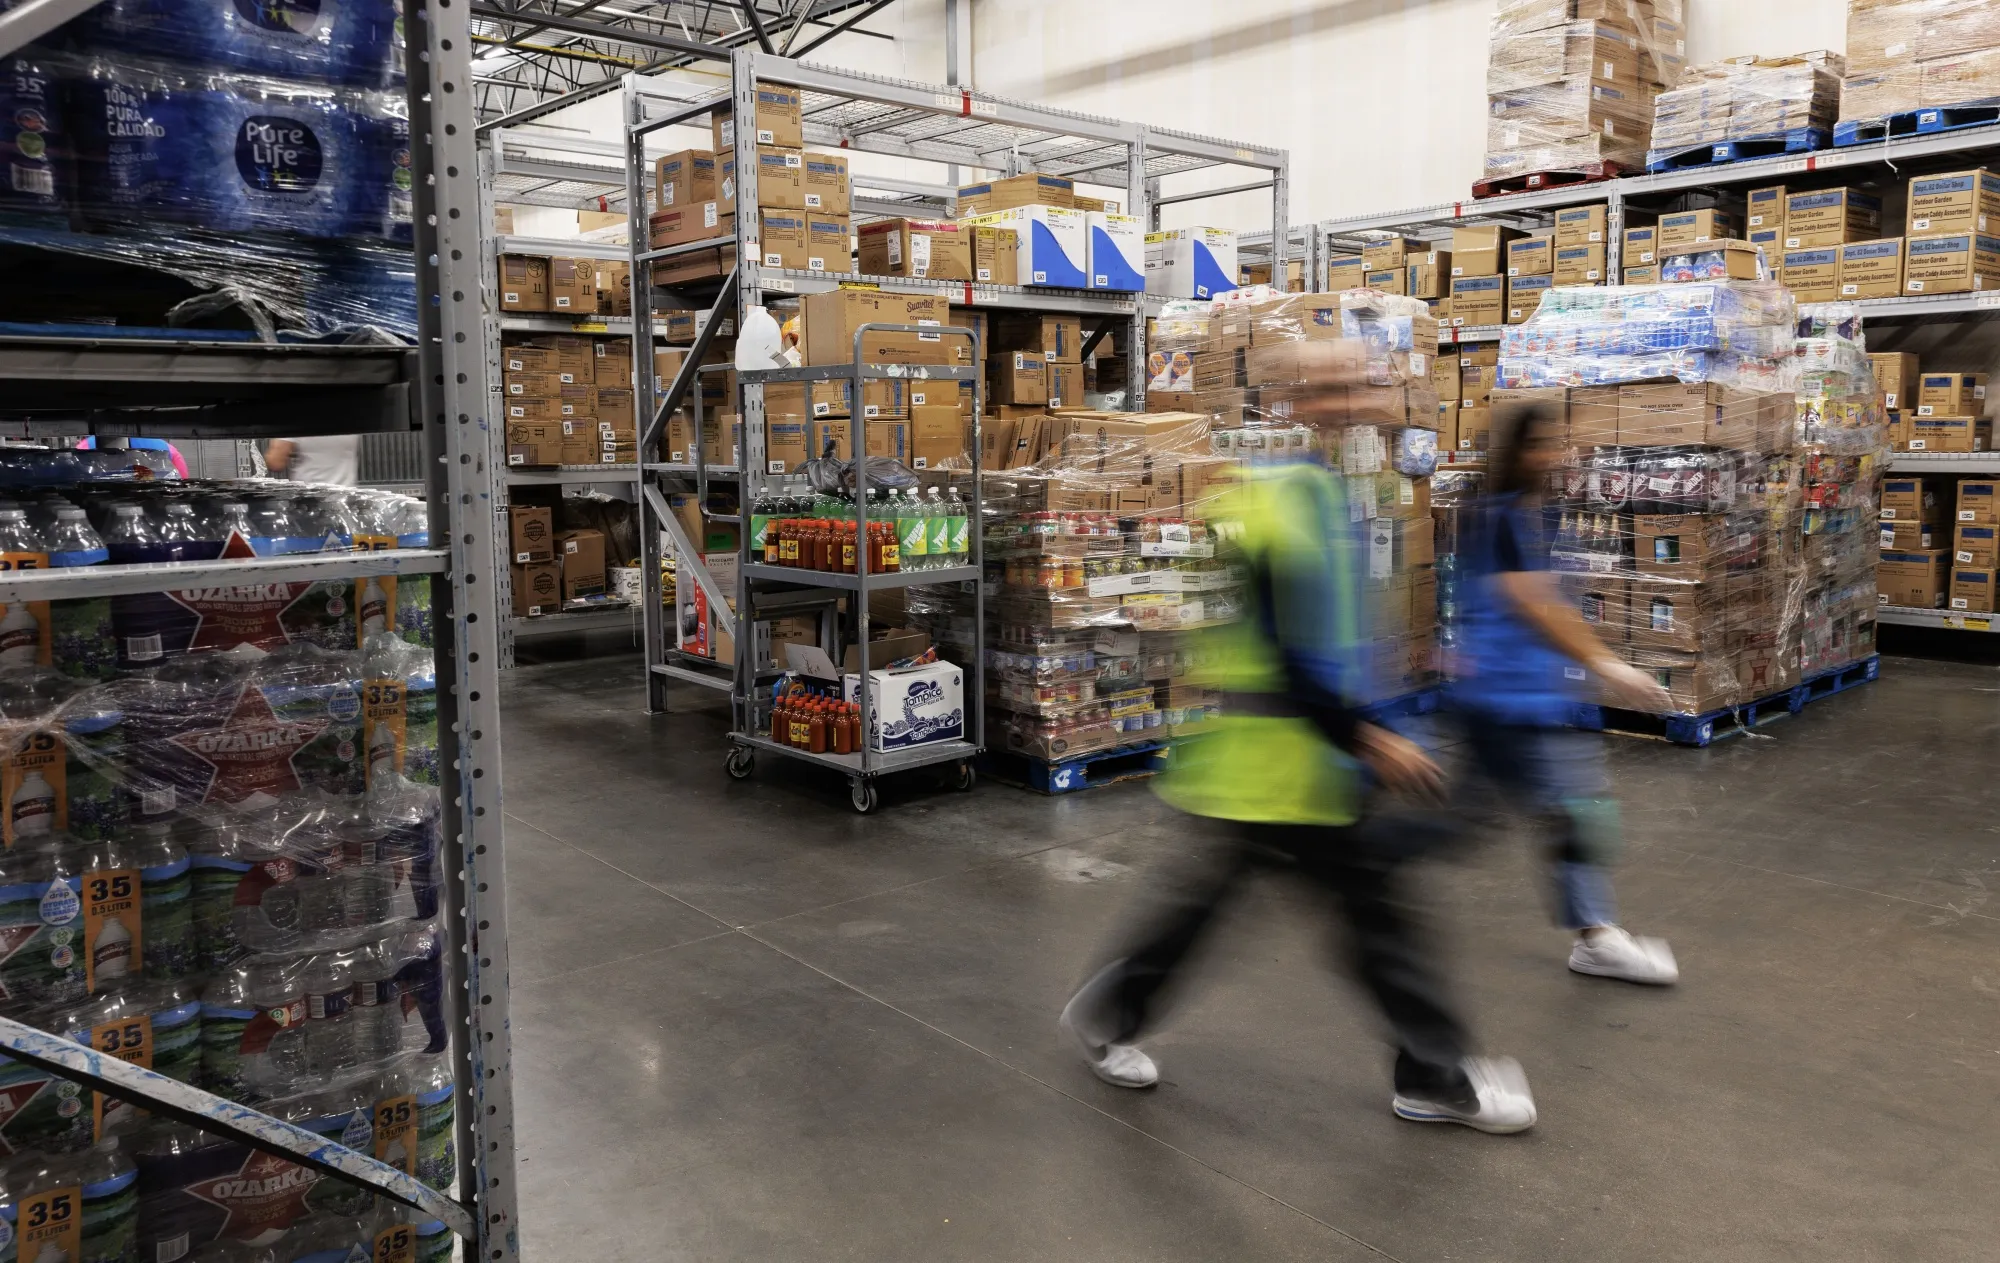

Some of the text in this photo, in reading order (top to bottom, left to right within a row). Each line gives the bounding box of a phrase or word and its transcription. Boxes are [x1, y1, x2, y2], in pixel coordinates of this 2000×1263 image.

[106, 105, 143, 122] PURA
[108, 121, 166, 137] CALIDAD
[246, 122, 304, 144] Pure
[254, 144, 298, 168] Life
[1944, 208, 1970, 216] Assortment
[907, 299, 934, 312] Suavitel
[182, 583, 291, 601] OZARKA
[368, 685, 399, 705] 35
[904, 688, 943, 707] Tampico
[198, 728, 302, 752] OZARKA
[910, 725, 937, 741] Tampico
[29, 755, 55, 766] LITER
[90, 876, 131, 901] 35
[92, 901, 132, 916] 0.5 LITER
[102, 1024, 143, 1052] 35
[380, 1101, 410, 1128] 35
[212, 1167, 316, 1198] OZARKA
[28, 1194, 72, 1228] 35
[45, 1222, 70, 1236] LITER
[379, 1229, 408, 1257] 35
